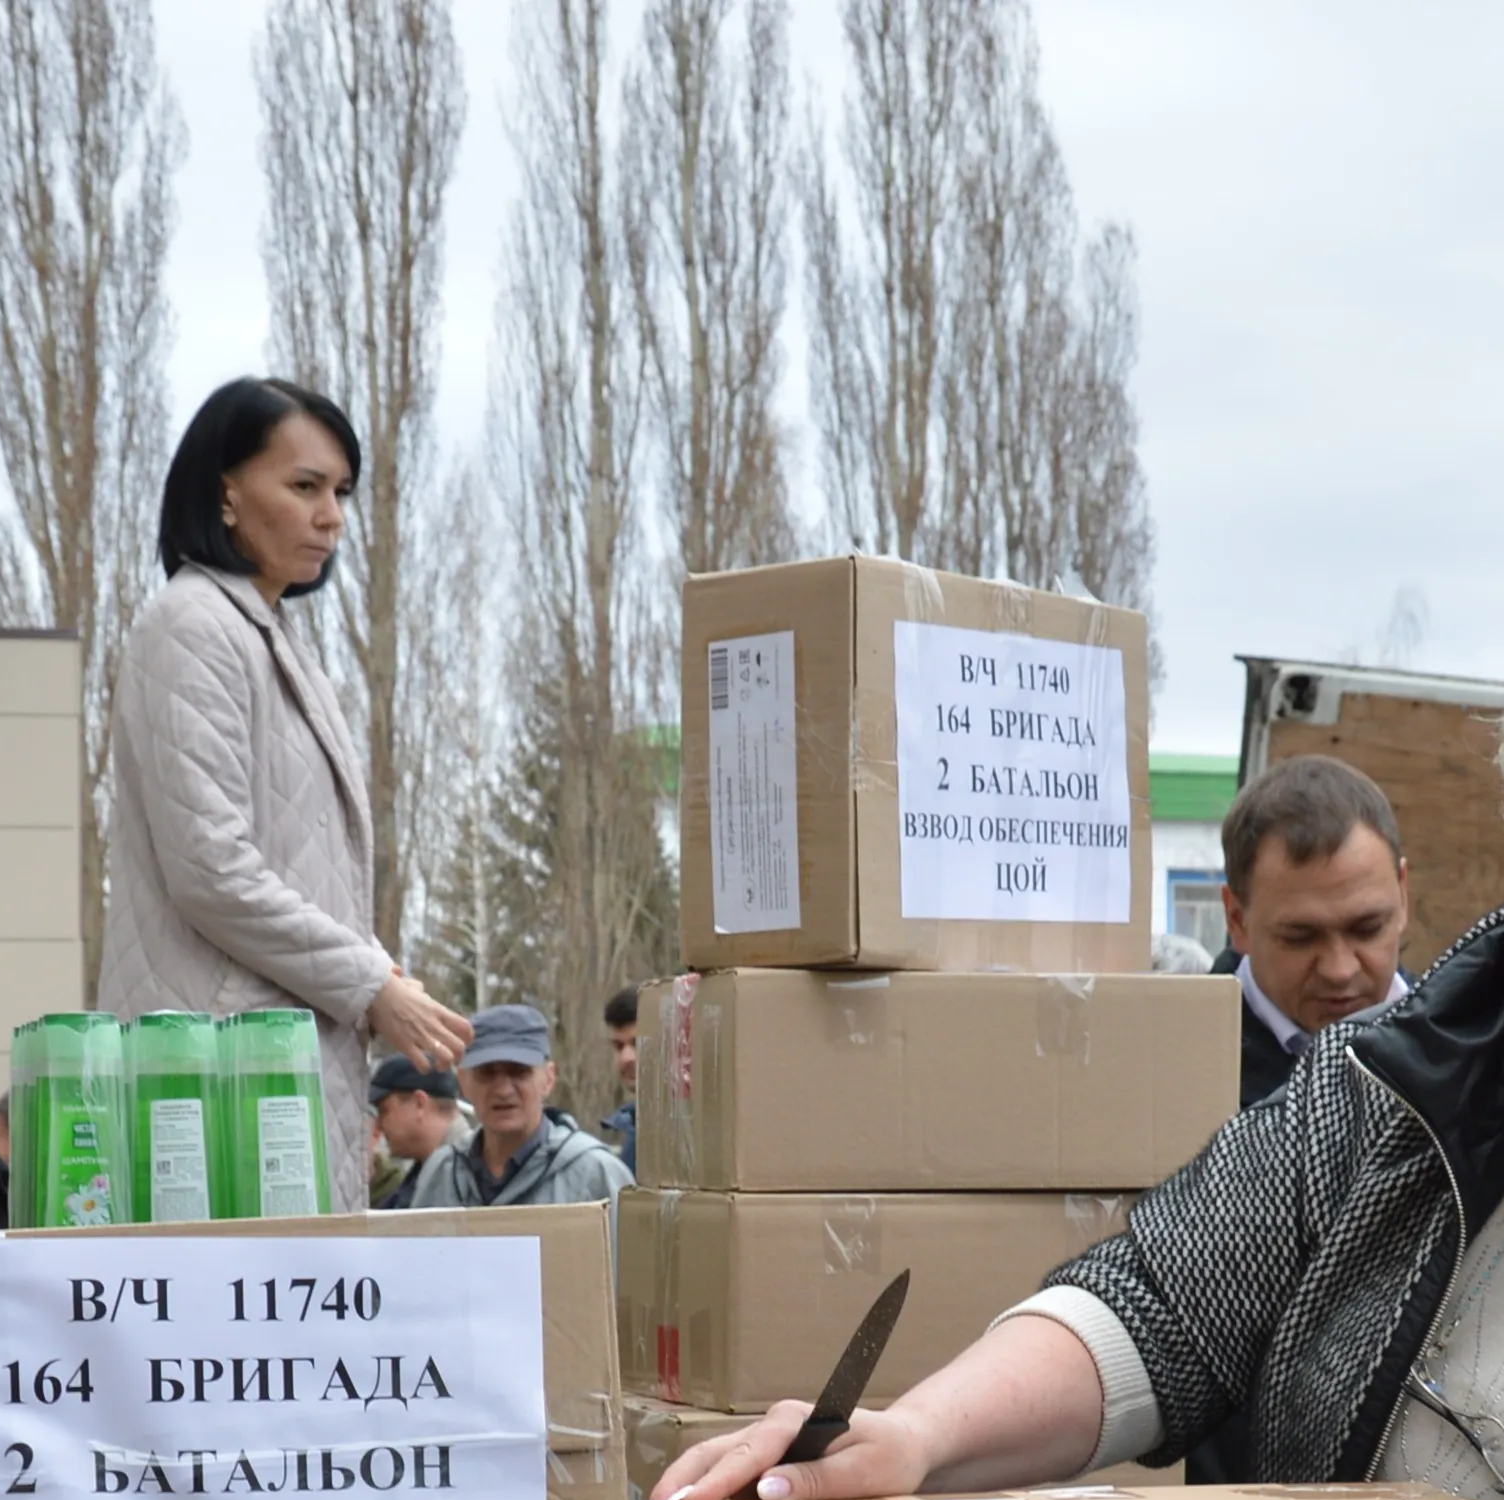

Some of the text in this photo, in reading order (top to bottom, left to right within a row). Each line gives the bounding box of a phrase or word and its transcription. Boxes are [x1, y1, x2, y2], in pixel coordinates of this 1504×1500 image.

[959, 653, 1071, 695] В/Ч 11740
[936, 703, 1097, 749] 164 БРИГАДА
[936, 756, 1100, 802] 2 БАТАЛЬОН
[903, 811, 1130, 851] ВЗВОД ОБЕСПЕЧЕНИЯ
[995, 855, 1049, 897] ЦОЙ
[69, 1276, 383, 1324] В/Ч 11740
[5, 1354, 453, 1410] 164 БРИГАДА
[2, 1441, 453, 1496] 2 БАТАЛЬОН
